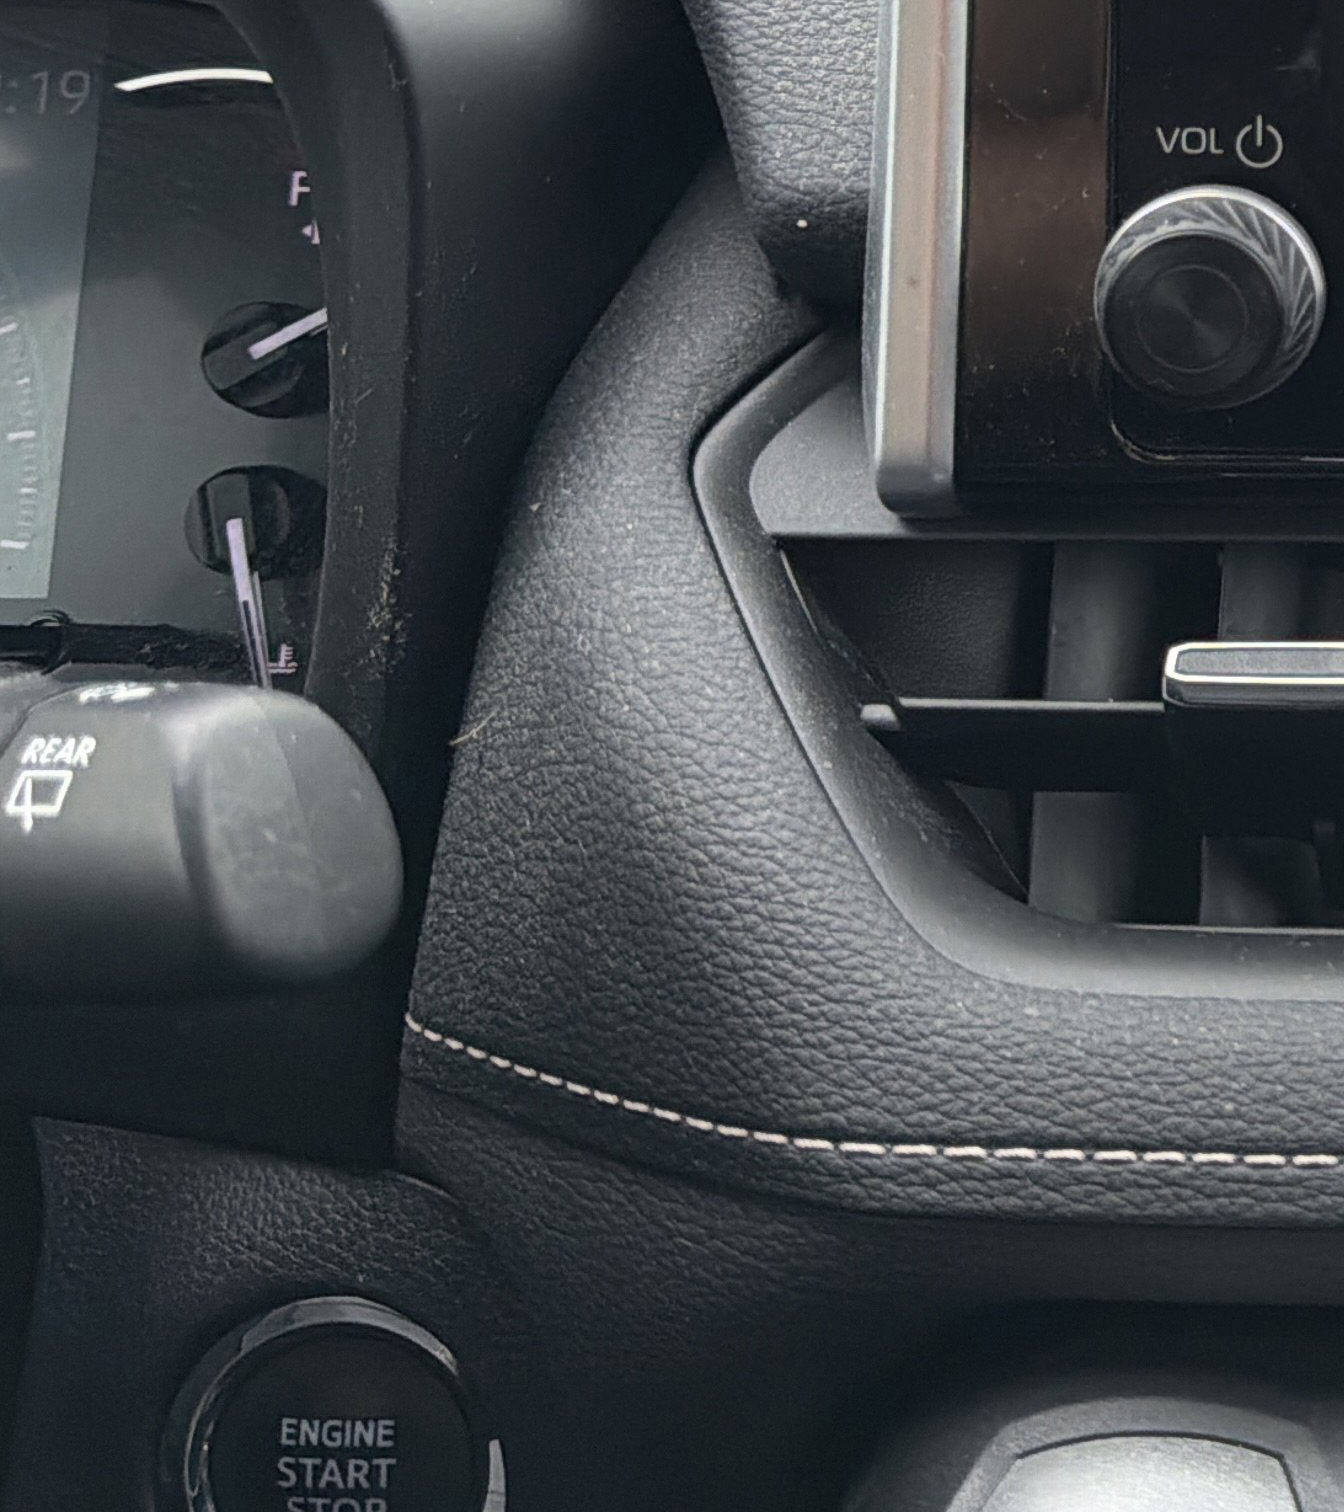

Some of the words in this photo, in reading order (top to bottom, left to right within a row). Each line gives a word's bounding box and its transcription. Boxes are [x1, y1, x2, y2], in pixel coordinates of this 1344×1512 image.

[0, 70, 91, 114] :19
[1155, 126, 1225, 155] VOL
[288, 170, 311, 207] F
[21, 735, 97, 767] REAR
[280, 1417, 395, 1448] ENGINE
[277, 1456, 397, 1489] START
